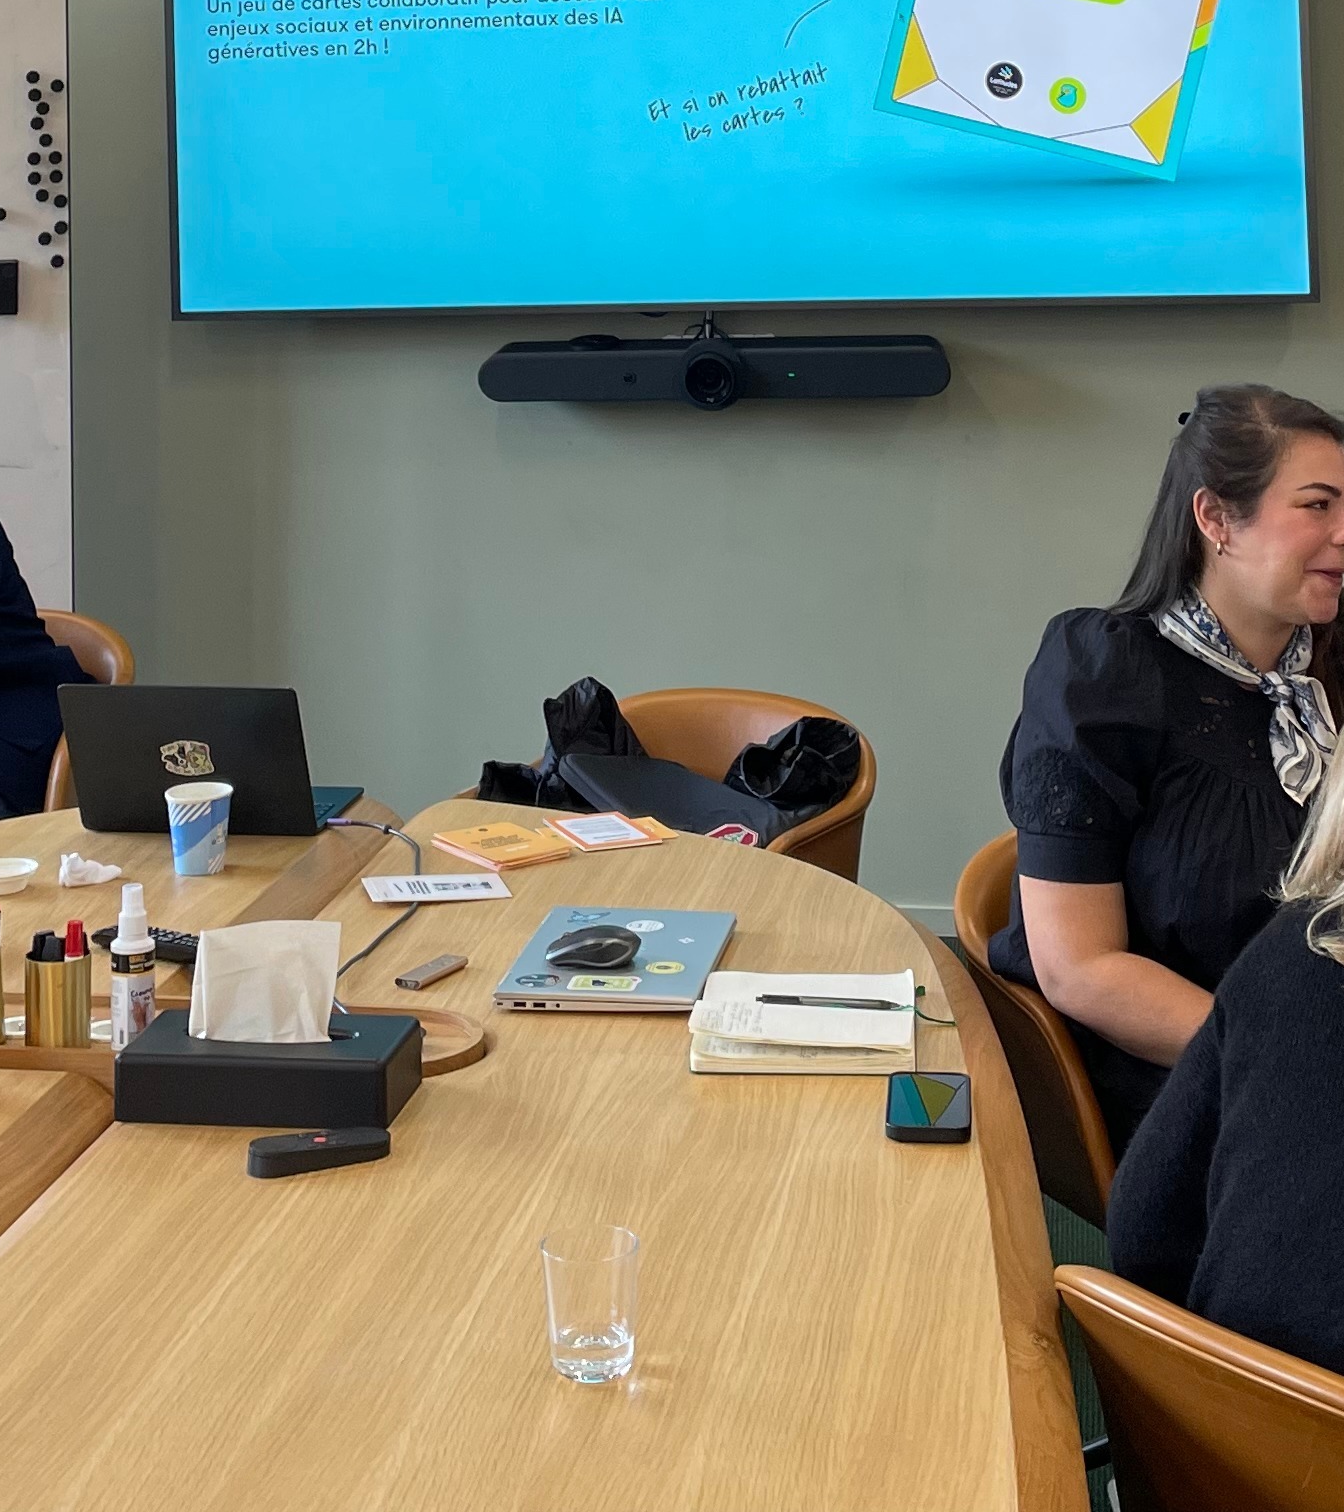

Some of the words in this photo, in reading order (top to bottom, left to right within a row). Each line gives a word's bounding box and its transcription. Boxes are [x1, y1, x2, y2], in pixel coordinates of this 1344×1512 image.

[207, 19, 270, 39] enjeux
[275, 17, 349, 34] sociaux
[354, 16, 373, 32] et
[379, 11, 559, 31] environnementaux
[564, 8, 599, 26] des
[605, 7, 624, 24] IA
[207, 40, 319, 64] génératives
[325, 44, 348, 57] en
[354, 38, 378, 56] 2h
[383, 37, 389, 55] !
[648, 98, 671, 121] Et
[682, 90, 699, 113] si
[708, 91, 729, 108] on
[737, 62, 828, 100] rebattait
[682, 121, 712, 142] les
[722, 105, 785, 133] cartes
[793, 97, 804, 115] ?
